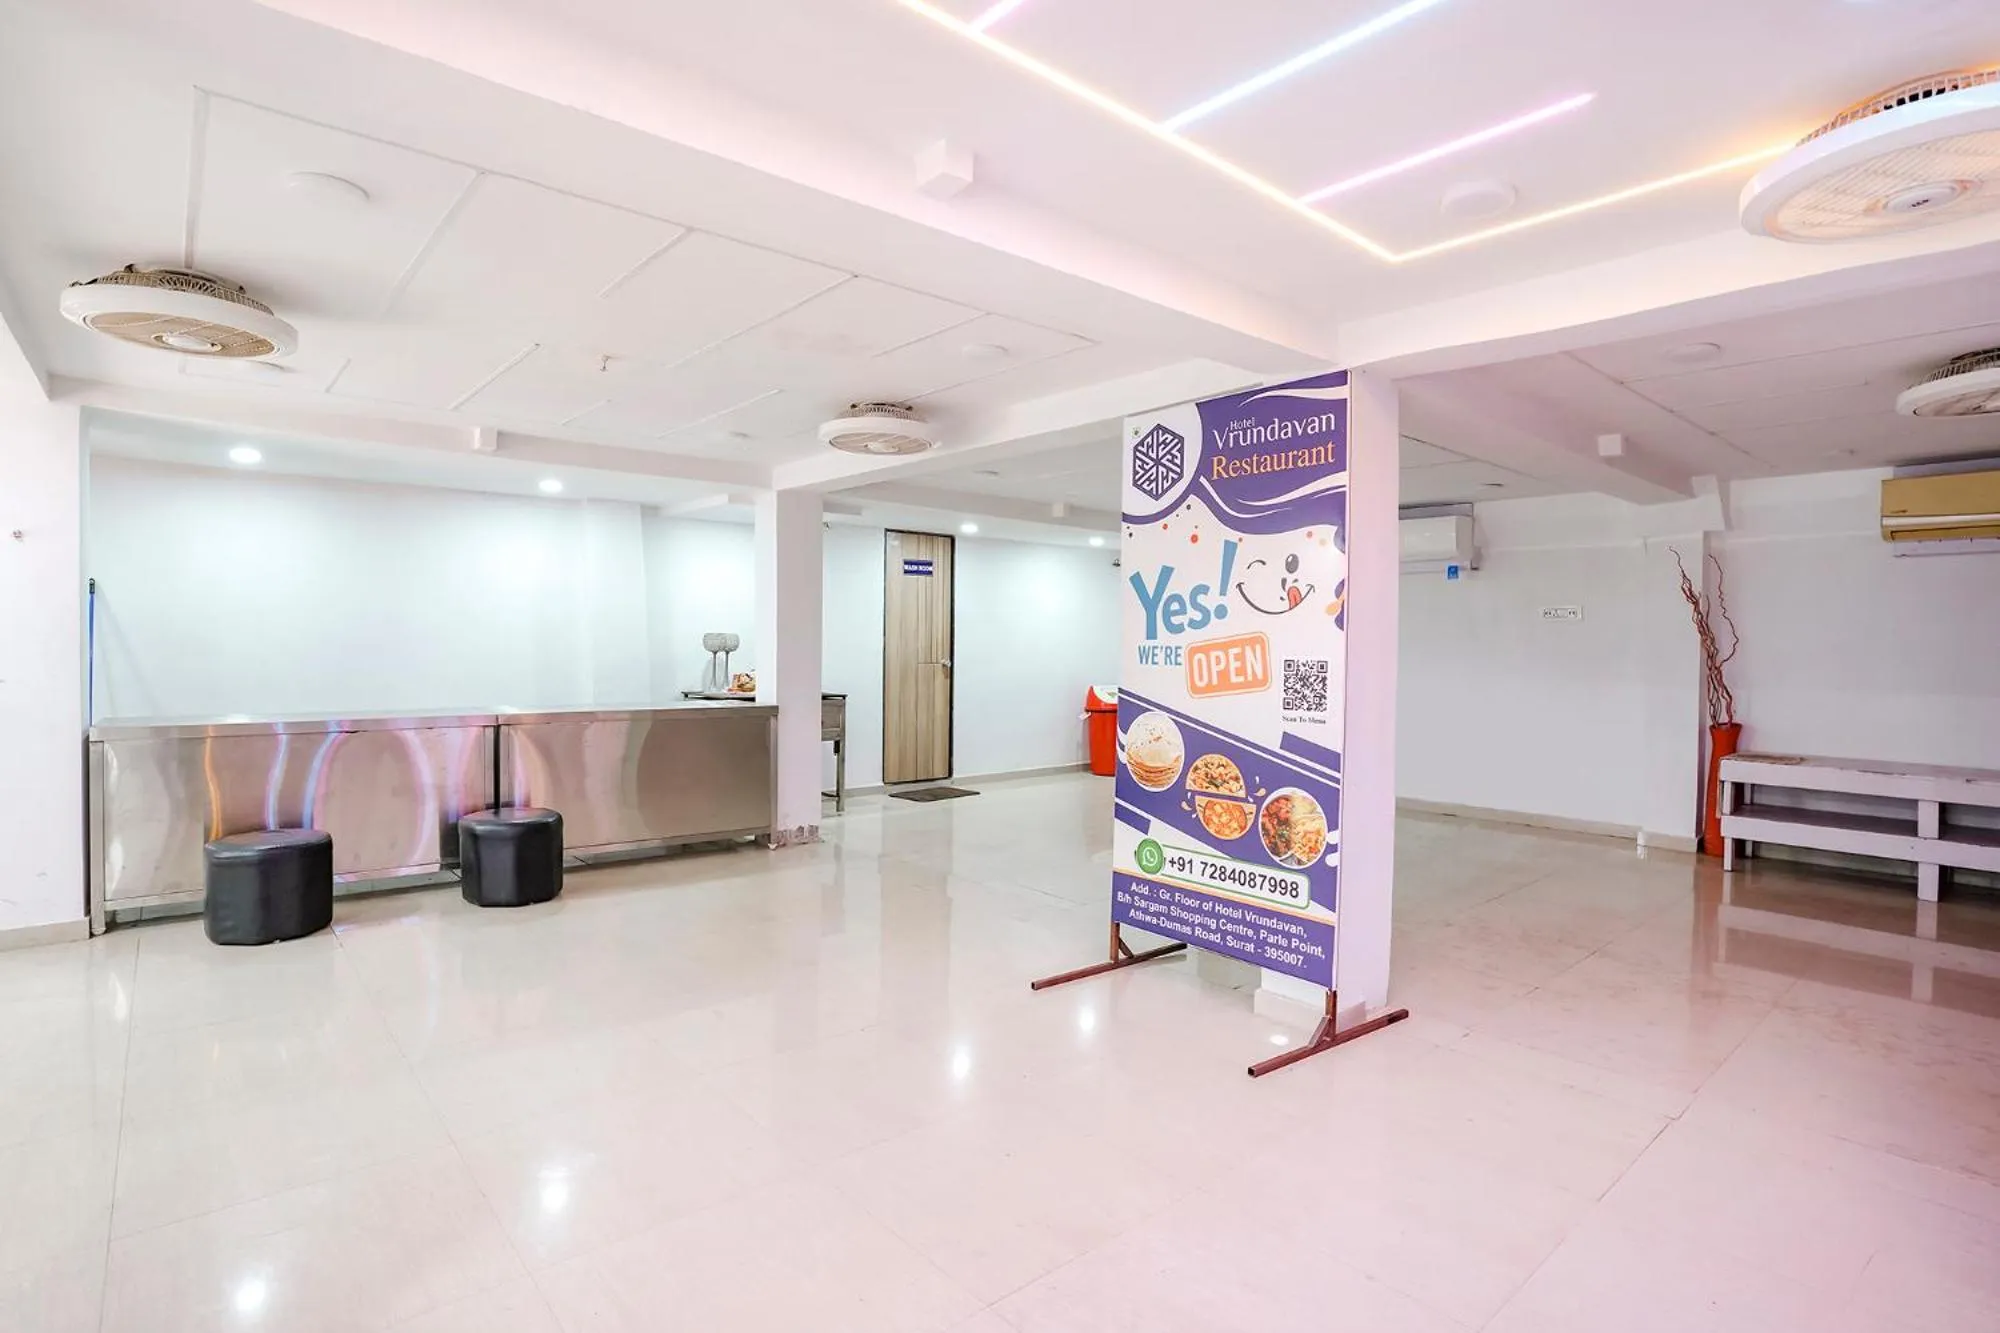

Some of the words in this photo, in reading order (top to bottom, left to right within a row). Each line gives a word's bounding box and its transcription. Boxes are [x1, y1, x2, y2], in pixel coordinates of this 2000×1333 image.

[1213, 413, 1335, 450] Vrundavan
[1230, 417, 1255, 431] Hotel
[1211, 440, 1336, 480] Restaurant
[1129, 539, 1238, 640] Yes!
[1138, 645, 1183, 666] WE'RE
[1192, 643, 1264, 688] OPEN
[1168, 856, 1193, 874] +91
[1200, 861, 1300, 899] 7284087998
[1131, 882, 1152, 896] Add.
[1159, 888, 1173, 901] Gr.
[1175, 892, 1201, 908] Floor
[1202, 901, 1213, 911] of
[1215, 902, 1242, 919] Hotel
[1244, 910, 1308, 938] Vrundavan,
[1134, 896, 1168, 914] Sargam
[1170, 905, 1217, 930] Shopping
[1219, 919, 1257, 940] Centre,
[1259, 929, 1288, 947] Parle
[1291, 938, 1326, 959] Point,
[1195, 926, 1224, 946] Road,
[1226, 935, 1255, 953] Surat
